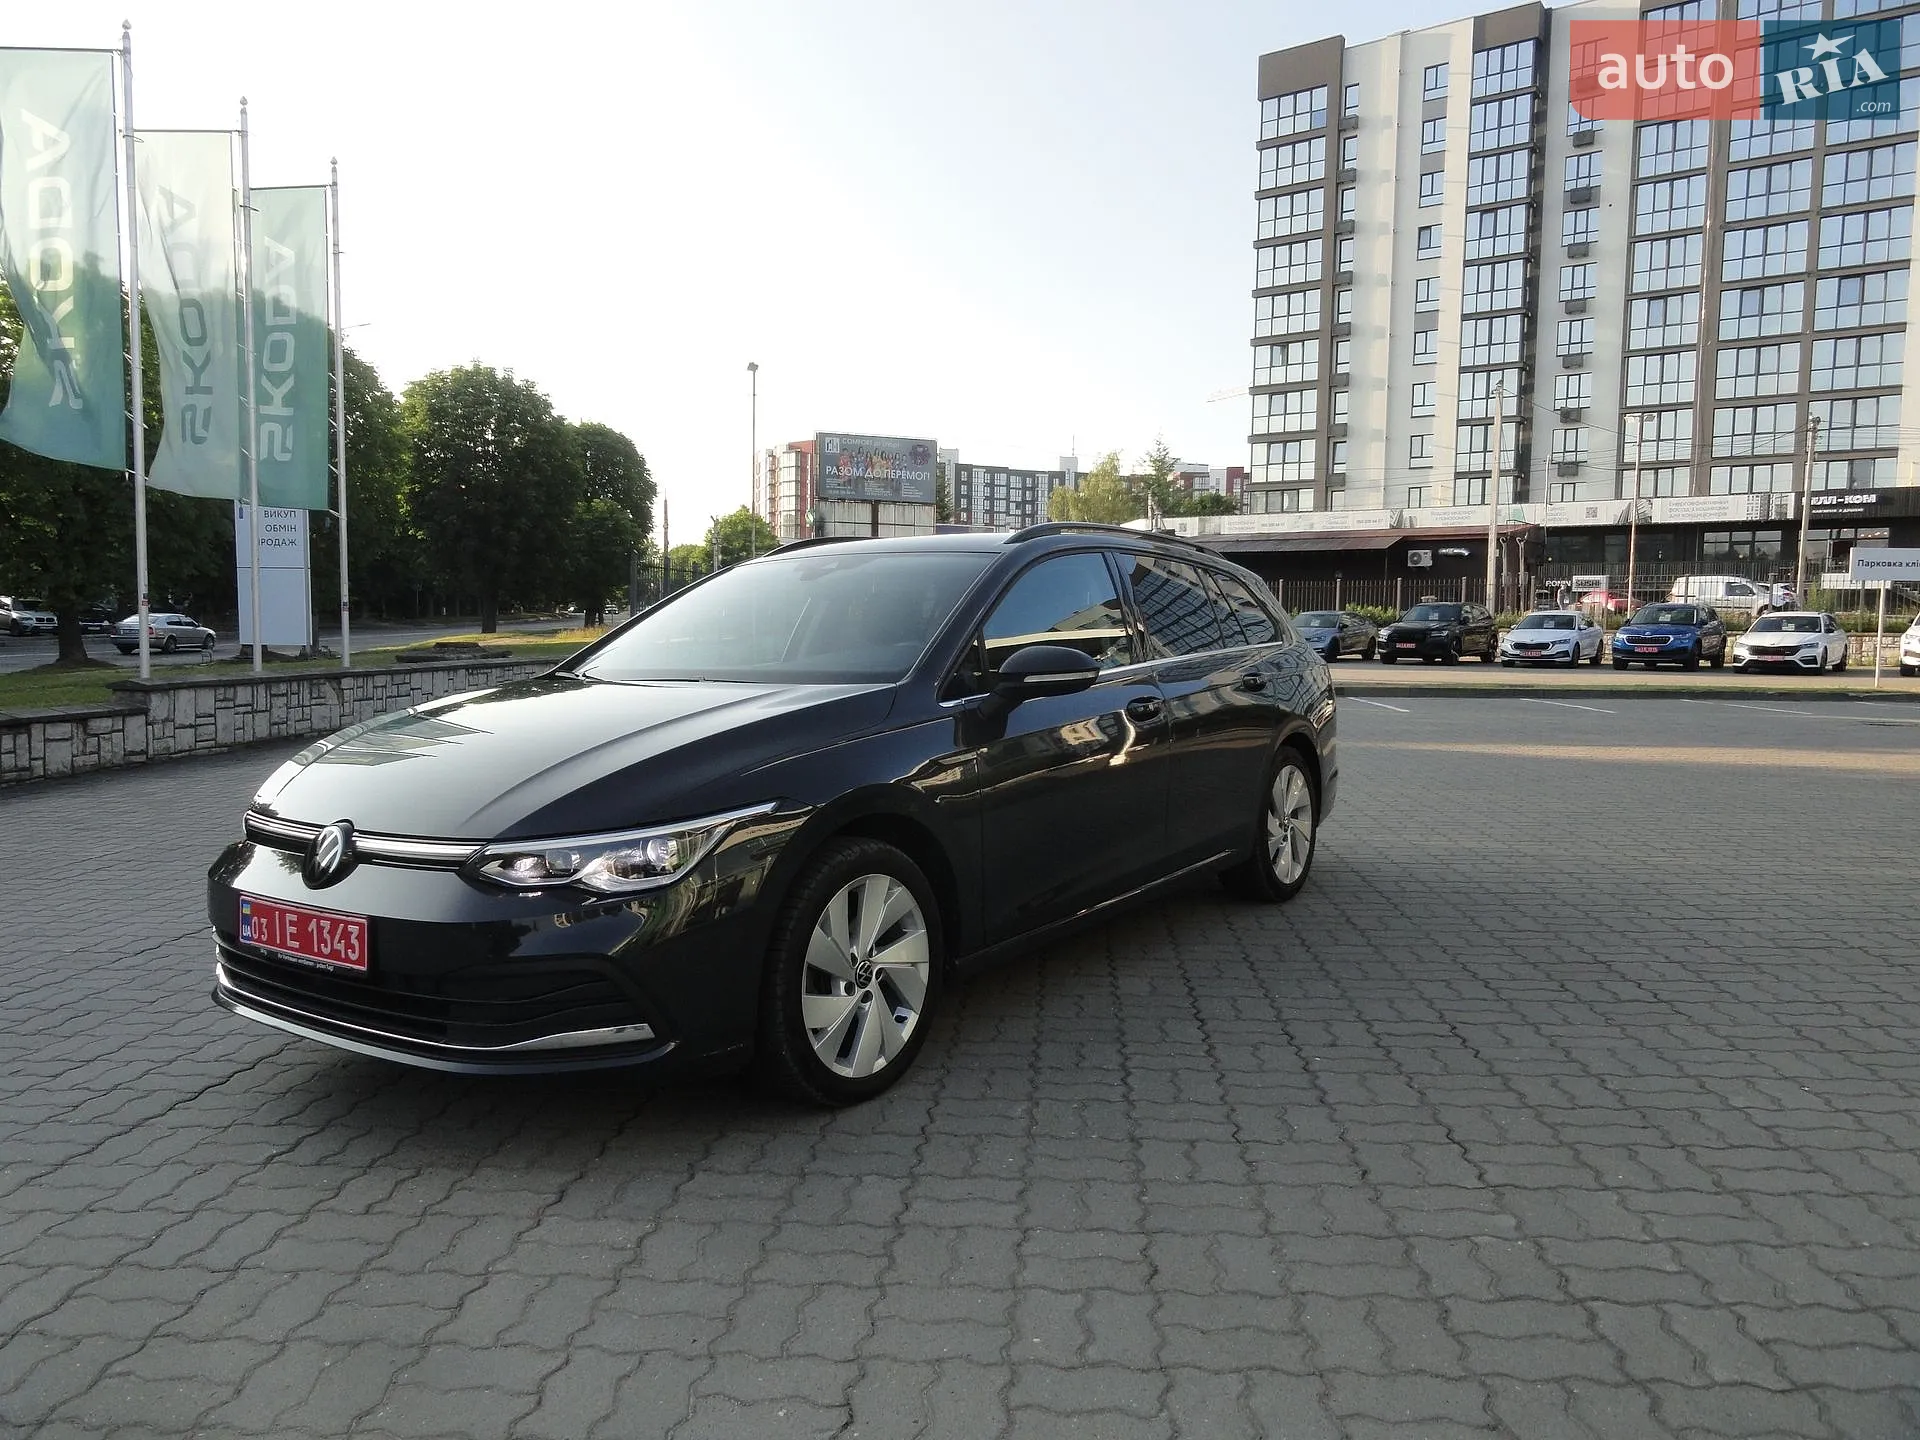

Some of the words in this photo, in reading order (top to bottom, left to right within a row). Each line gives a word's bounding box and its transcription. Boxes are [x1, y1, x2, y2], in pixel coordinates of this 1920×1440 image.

[826, 466, 863, 477] РАЗОМ
[865, 468, 881, 478] ДО
[264, 510, 297, 518] ВИКУП
[265, 524, 297, 532] ОБМІН
[1857, 560, 1903, 569] Парковка
[1906, 559, 1920, 568] клі
[242, 924, 252, 938] UA
[252, 916, 268, 942] 03
[308, 918, 360, 961] 1343
